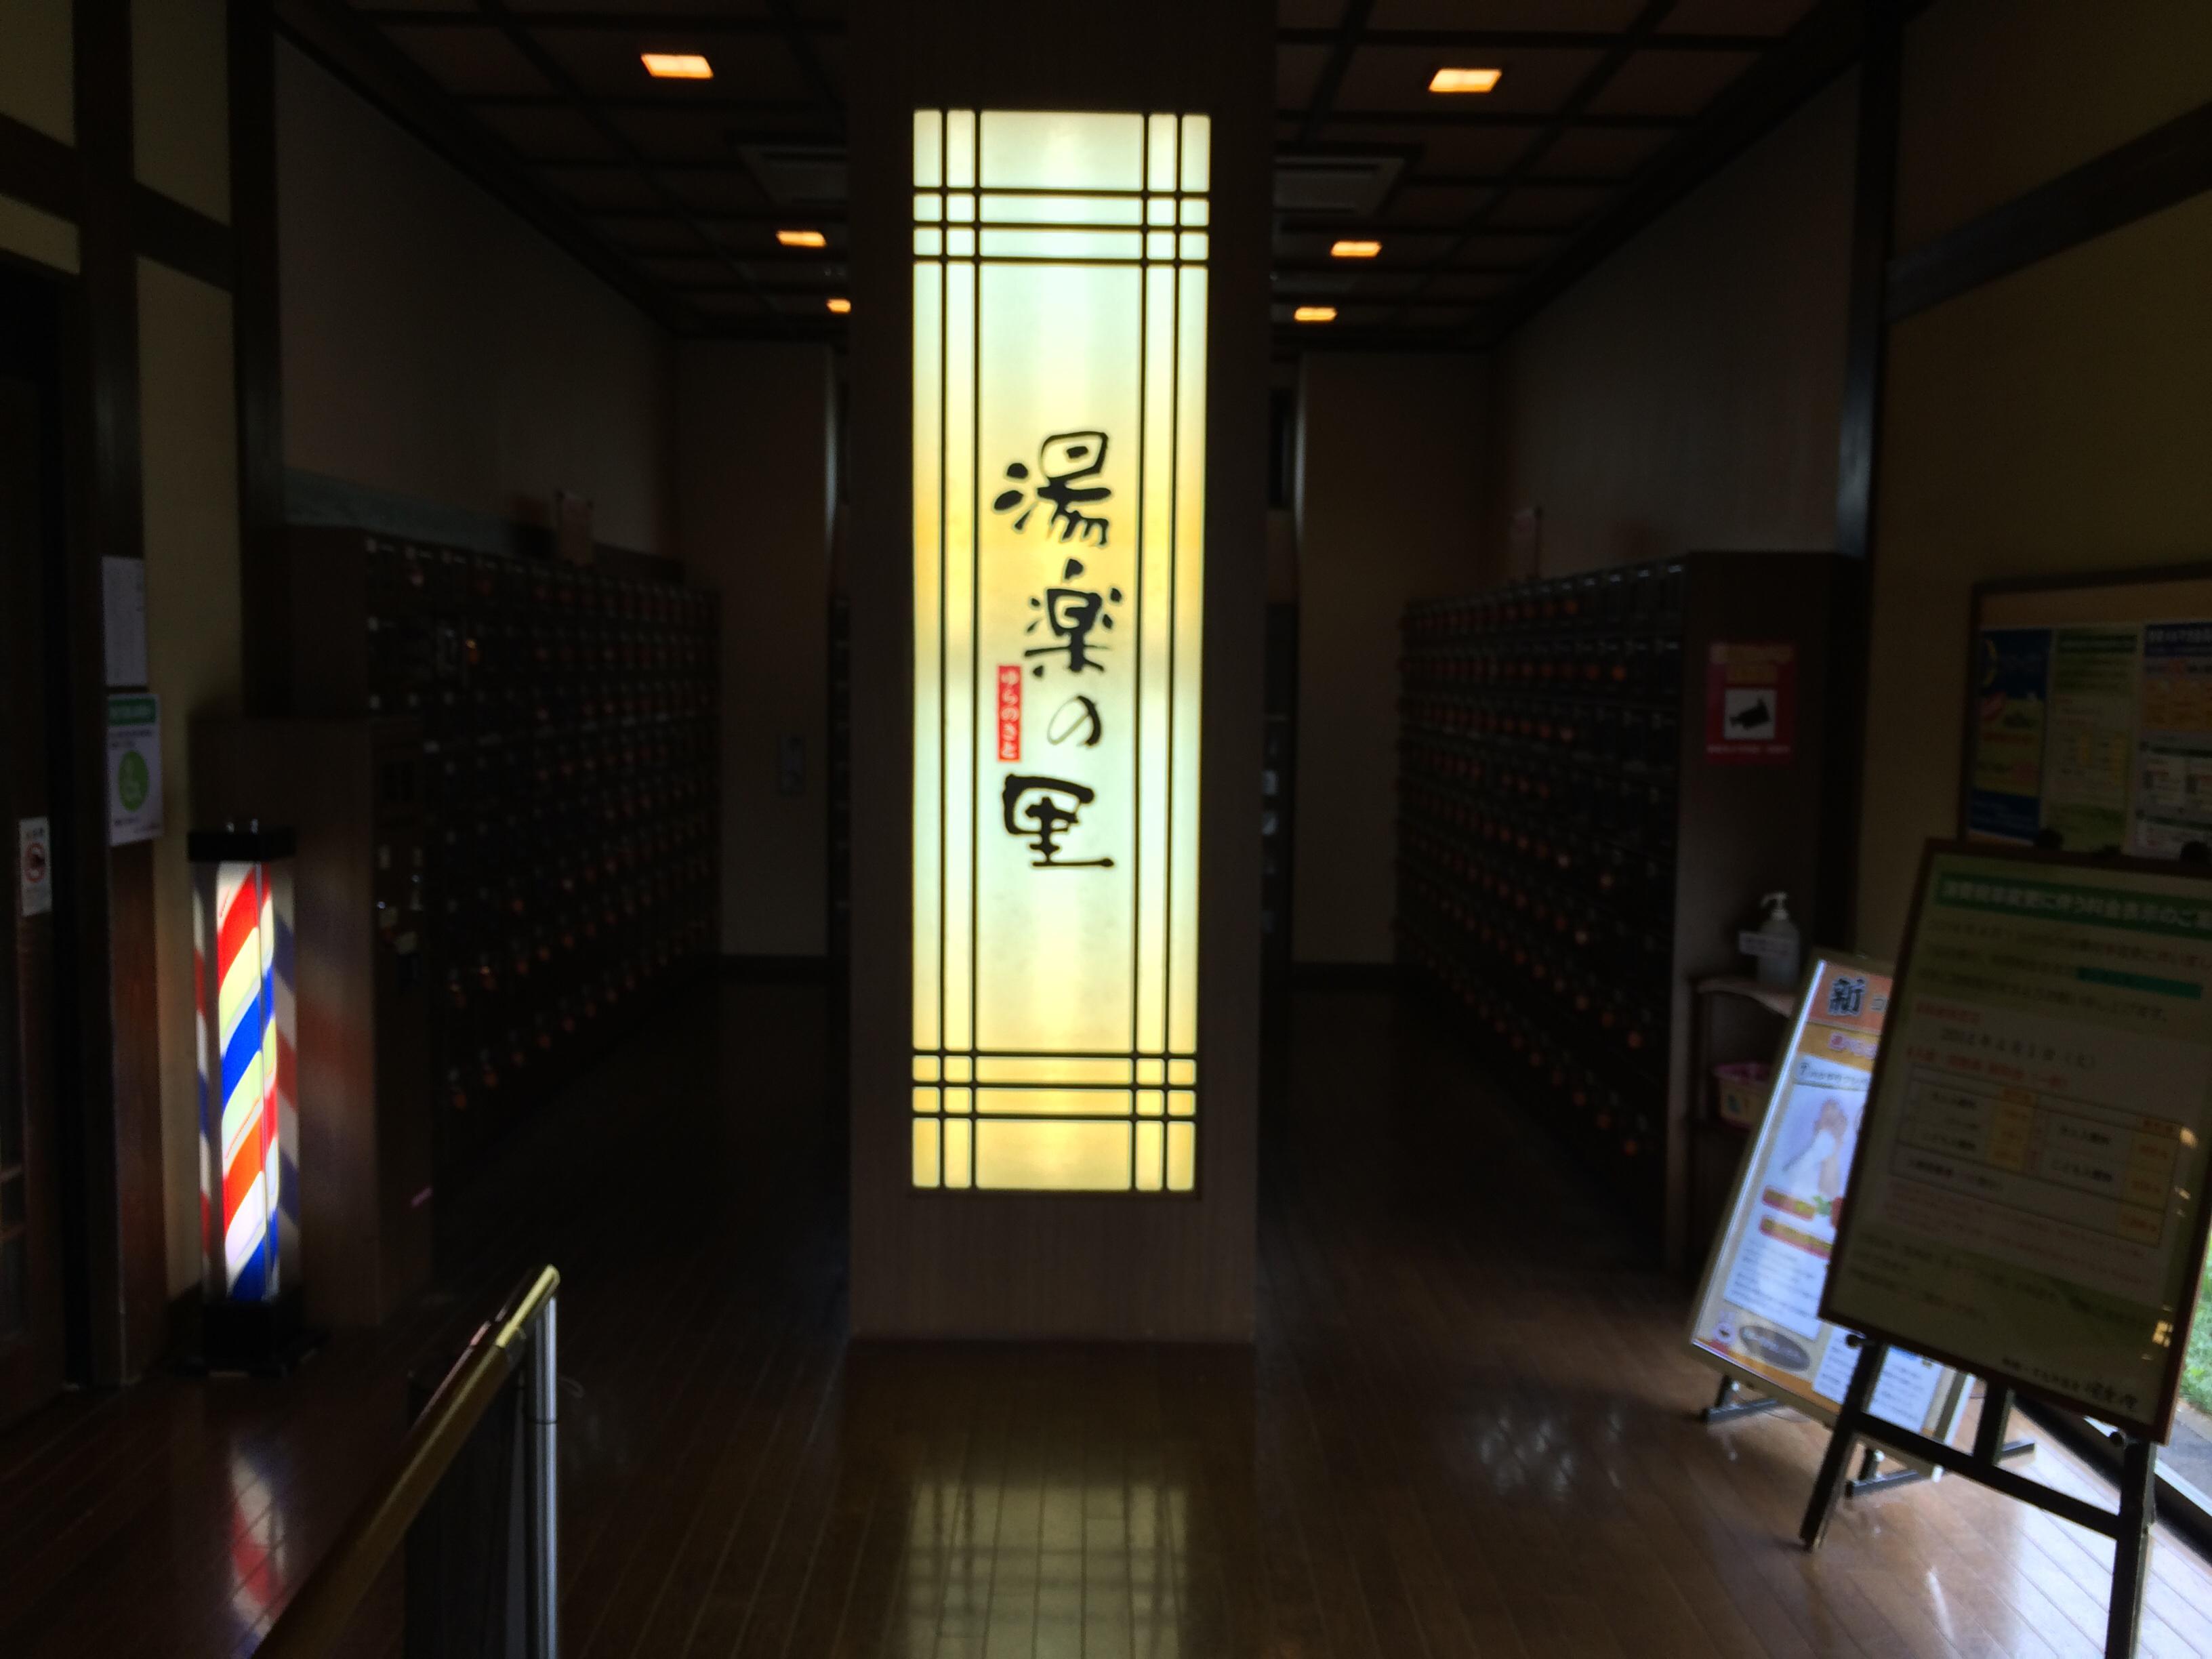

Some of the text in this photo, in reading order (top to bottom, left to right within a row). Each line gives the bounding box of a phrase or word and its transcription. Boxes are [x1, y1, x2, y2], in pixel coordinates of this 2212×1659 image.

[994, 430, 1122, 869] 湯楽の里
[1829, 977, 1865, 1015] 新
